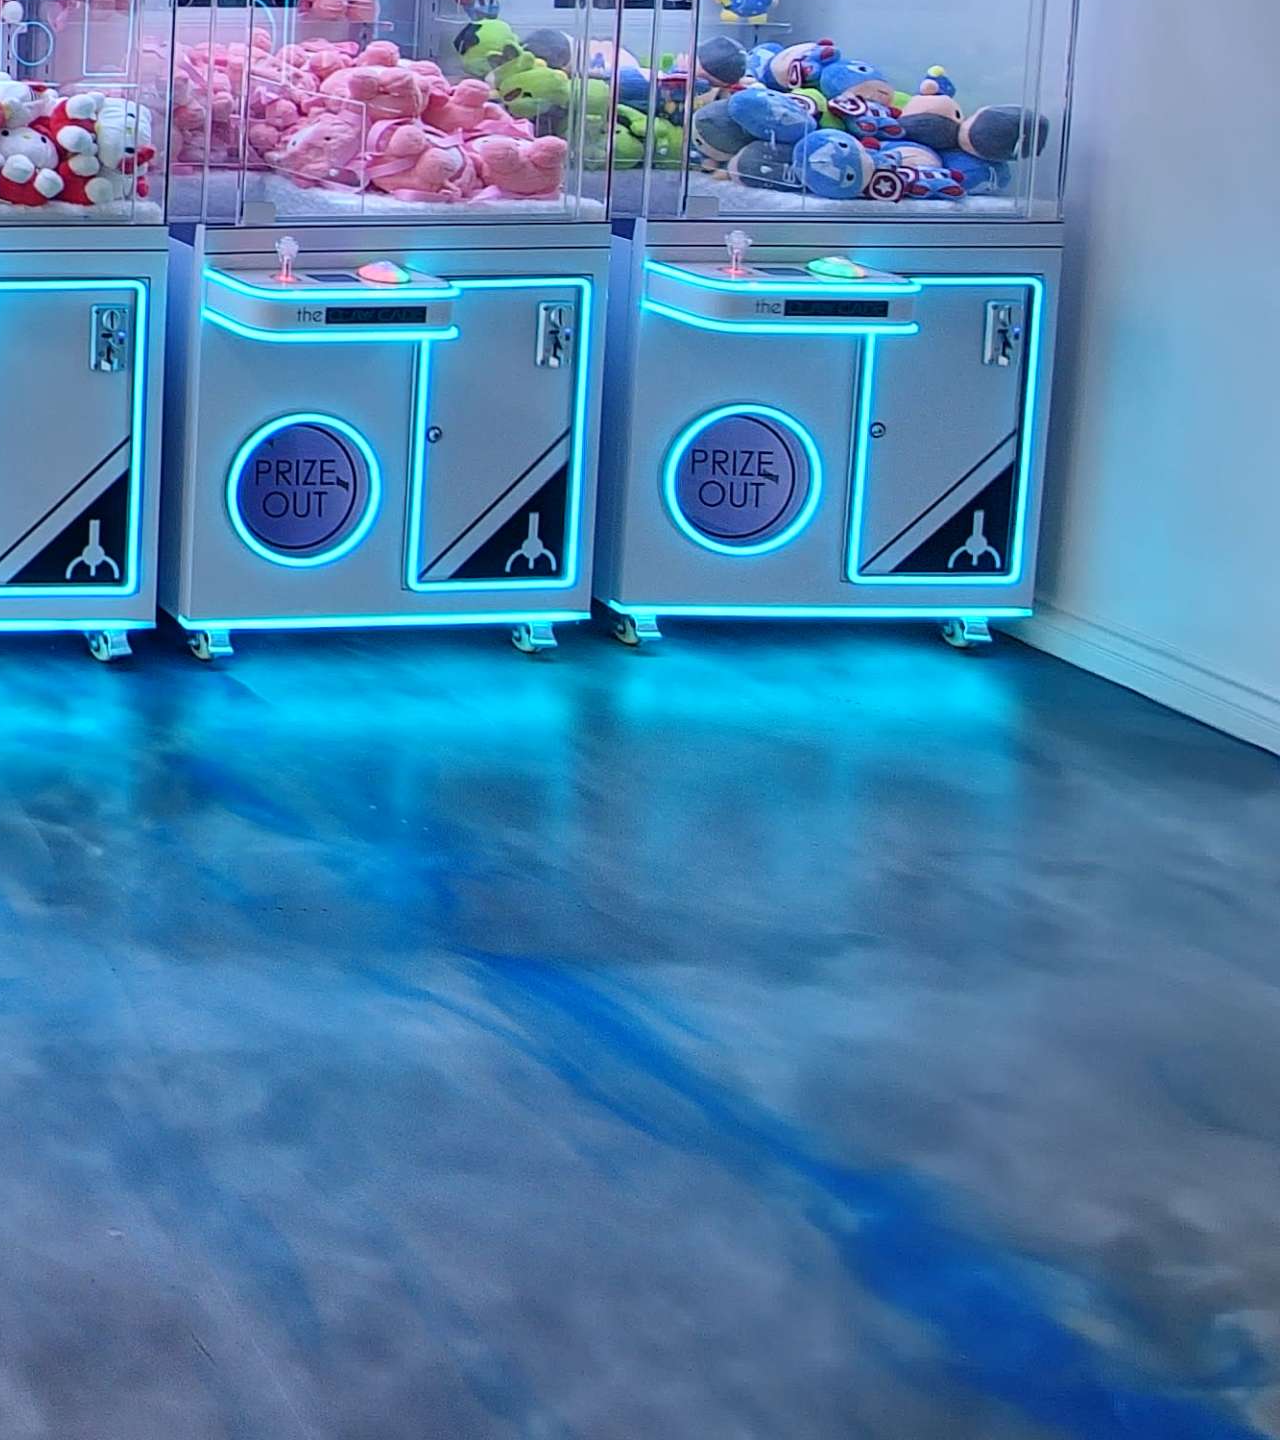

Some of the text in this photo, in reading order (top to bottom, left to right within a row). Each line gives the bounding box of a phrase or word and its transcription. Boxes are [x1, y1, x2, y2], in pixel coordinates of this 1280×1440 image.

[297, 307, 323, 323] the
[755, 298, 782, 314] the
[255, 459, 336, 486] PRIZE
[691, 449, 774, 476] PRIZE
[263, 491, 328, 518] OUT
[698, 480, 766, 507] OUT
